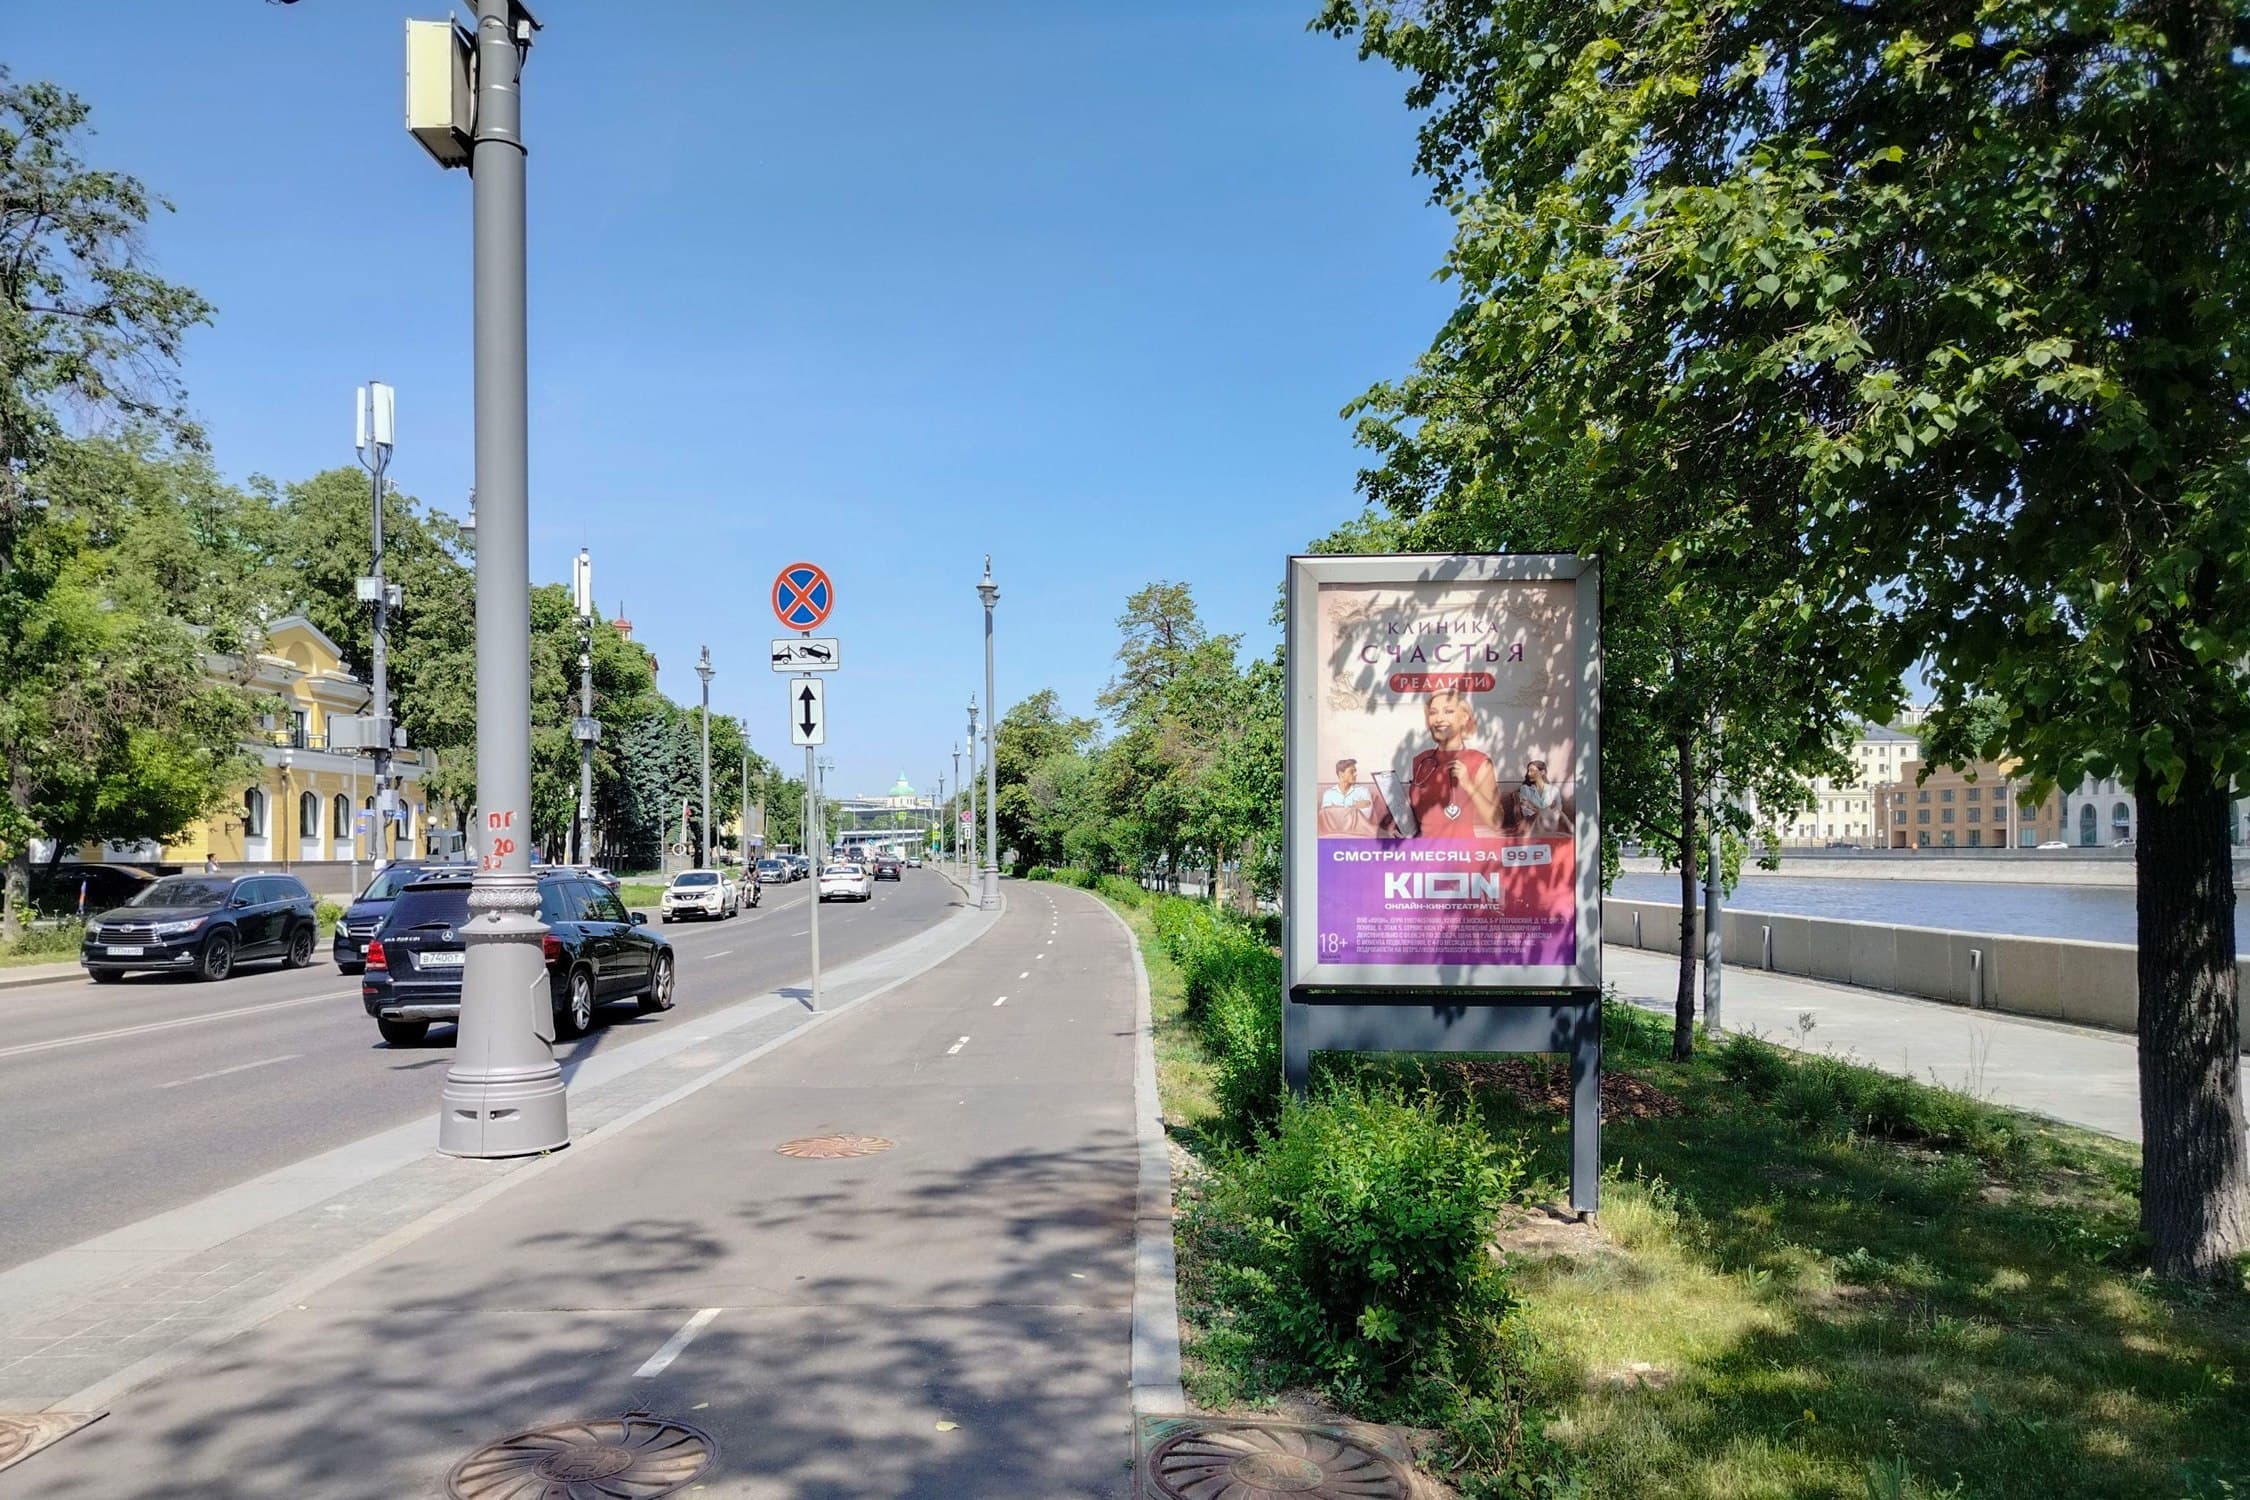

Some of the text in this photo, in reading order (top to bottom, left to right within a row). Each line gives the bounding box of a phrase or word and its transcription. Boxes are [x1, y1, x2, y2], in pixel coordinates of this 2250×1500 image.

[1388, 620, 1499, 635] КЛИНИКА
[1360, 643, 1524, 664] СЧАСТЬЯ
[1400, 676, 1486, 689] РЕАЛИТИ
[494, 838, 515, 857] 20
[1333, 850, 1406, 862] СМОТРИ
[1410, 850, 1471, 864] МЕСЯЦ
[1474, 850, 1498, 862] ЗА
[1506, 850, 1528, 861] 99
[1384, 872, 1500, 899] KION
[1384, 901, 1479, 910] ОНЛАЙН-КИНОТЕАТР
[1319, 932, 1349, 953] 18+
